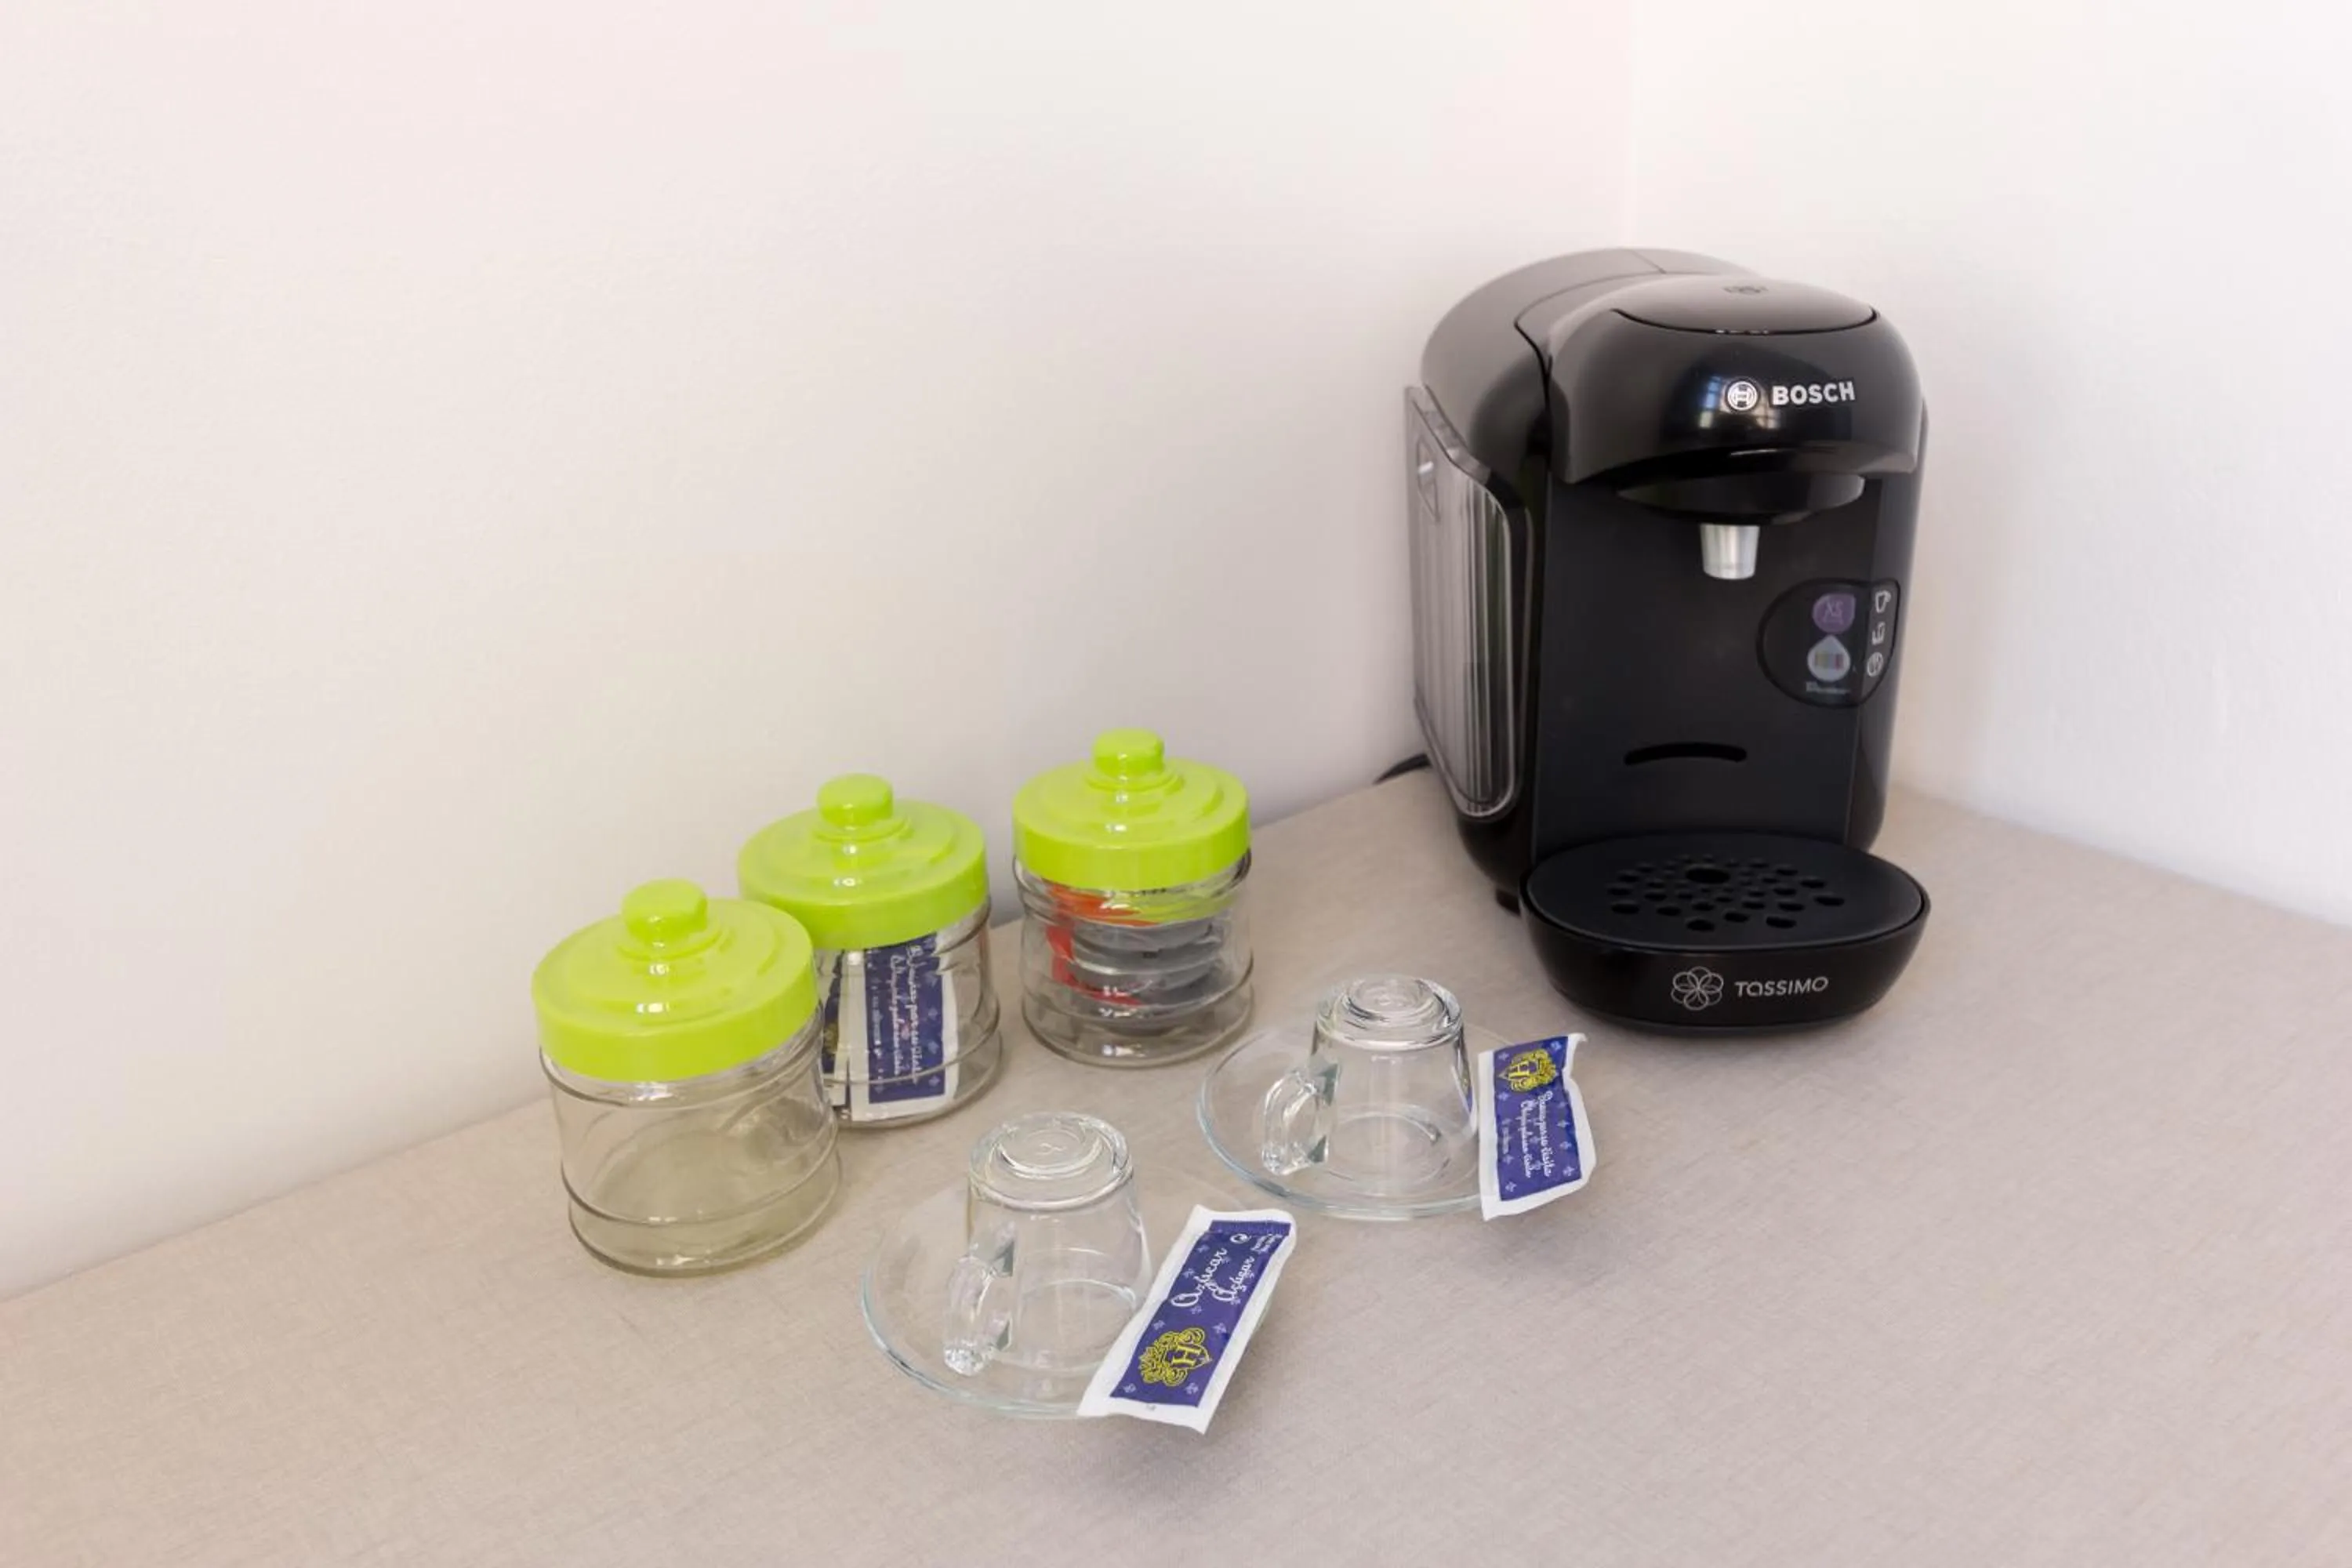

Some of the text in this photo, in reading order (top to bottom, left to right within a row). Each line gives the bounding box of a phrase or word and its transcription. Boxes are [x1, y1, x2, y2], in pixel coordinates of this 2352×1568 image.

[1772, 381, 1856, 405] BOSCH
[1734, 976, 1829, 997] TASSIMO
[1171, 1343, 1203, 1368] H
